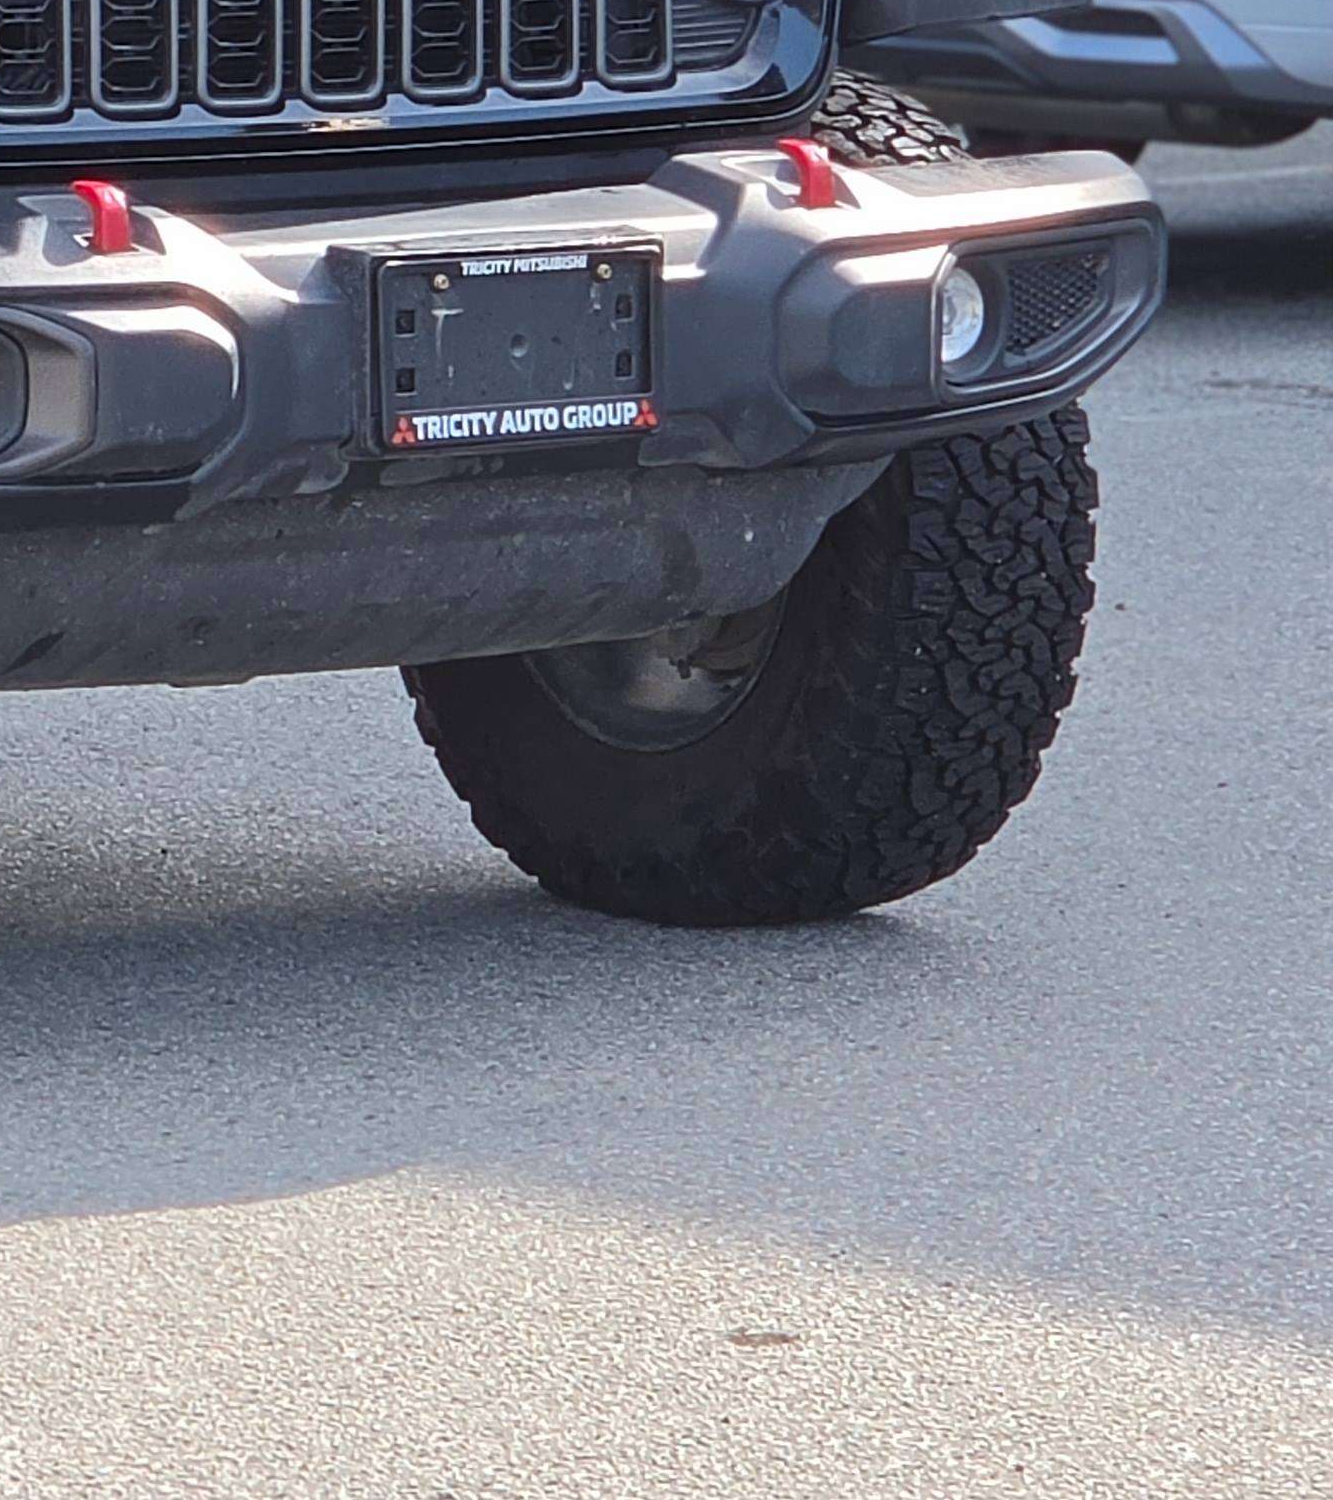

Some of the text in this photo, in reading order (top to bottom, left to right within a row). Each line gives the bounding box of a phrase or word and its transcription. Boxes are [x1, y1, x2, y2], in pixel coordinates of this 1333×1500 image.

[460, 254, 589, 278] TRICITY MITSUBISHI
[411, 400, 639, 442] TRICITY AUTO GROUP
